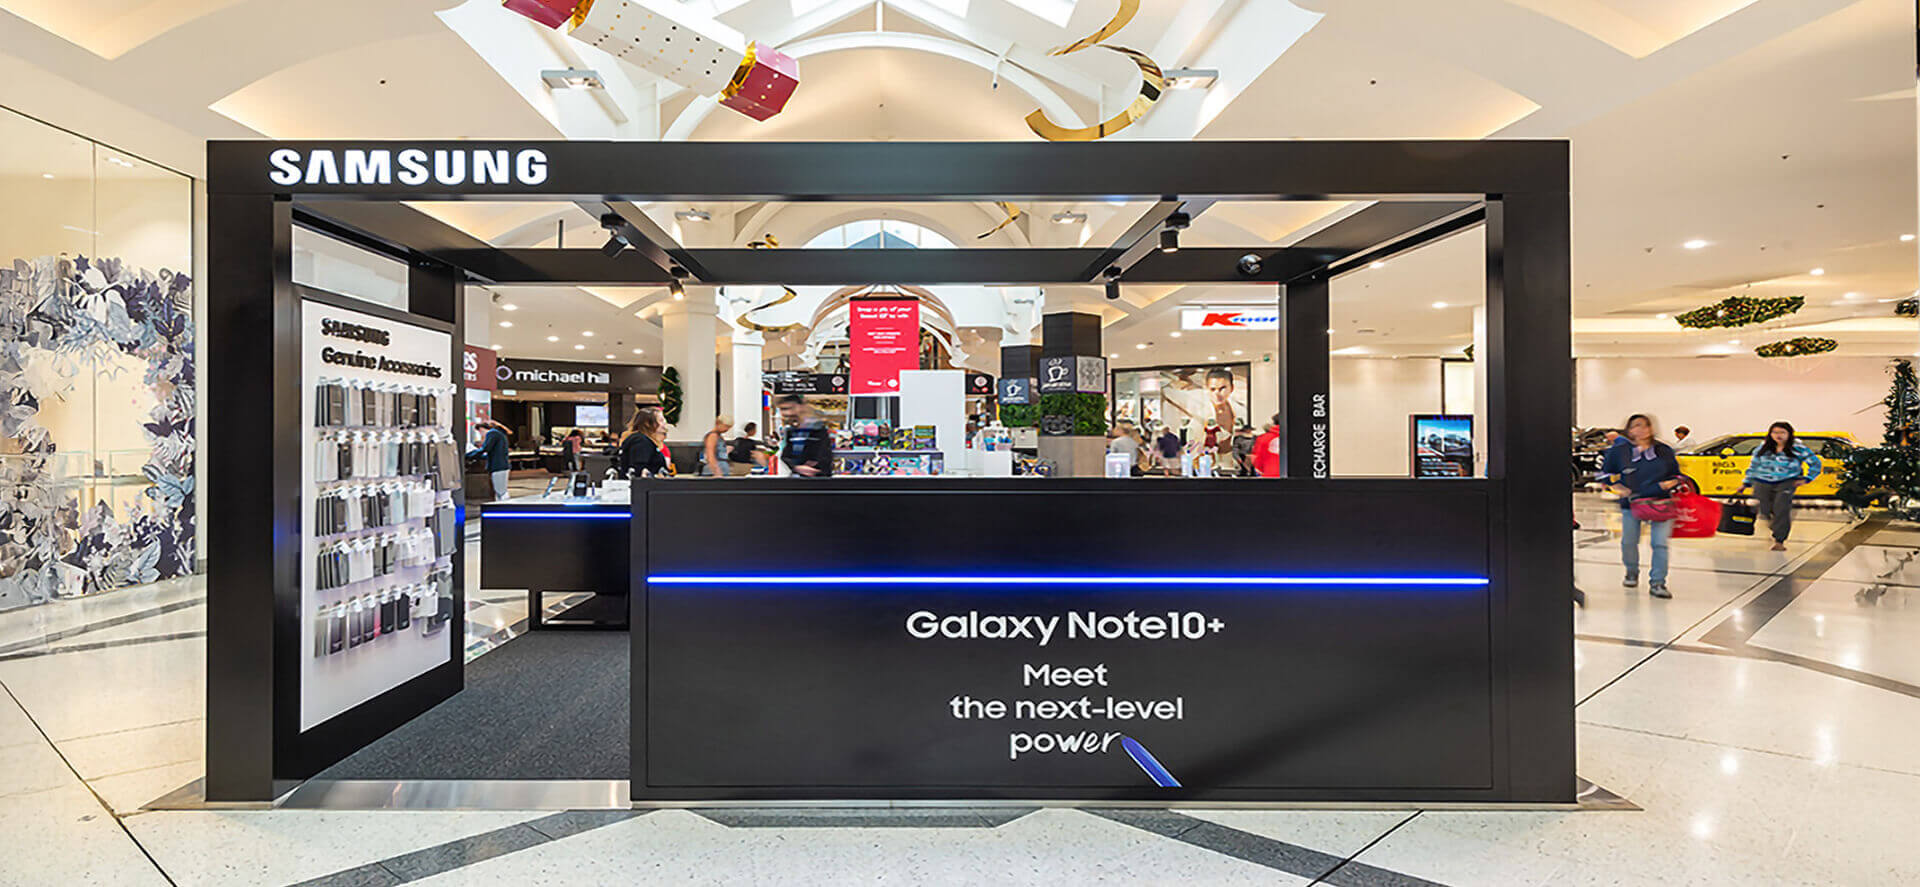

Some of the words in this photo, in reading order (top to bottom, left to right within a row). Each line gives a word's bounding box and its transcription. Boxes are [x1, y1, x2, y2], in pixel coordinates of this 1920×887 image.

[269, 149, 548, 185] SAMSUNG
[321, 318, 390, 346] SAMSUNG
[322, 347, 377, 369] Genuine
[378, 356, 442, 378] Accessories
[515, 369, 585, 383] michael
[587, 372, 610, 384] hill
[1313, 394, 1327, 418] BAR
[906, 610, 1060, 646] Galaxy
[1068, 610, 1226, 640] Note10+
[1023, 663, 1109, 687] Meet
[950, 696, 1007, 720] the
[1015, 696, 1184, 720] next-level
[1010, 730, 1121, 760] power
